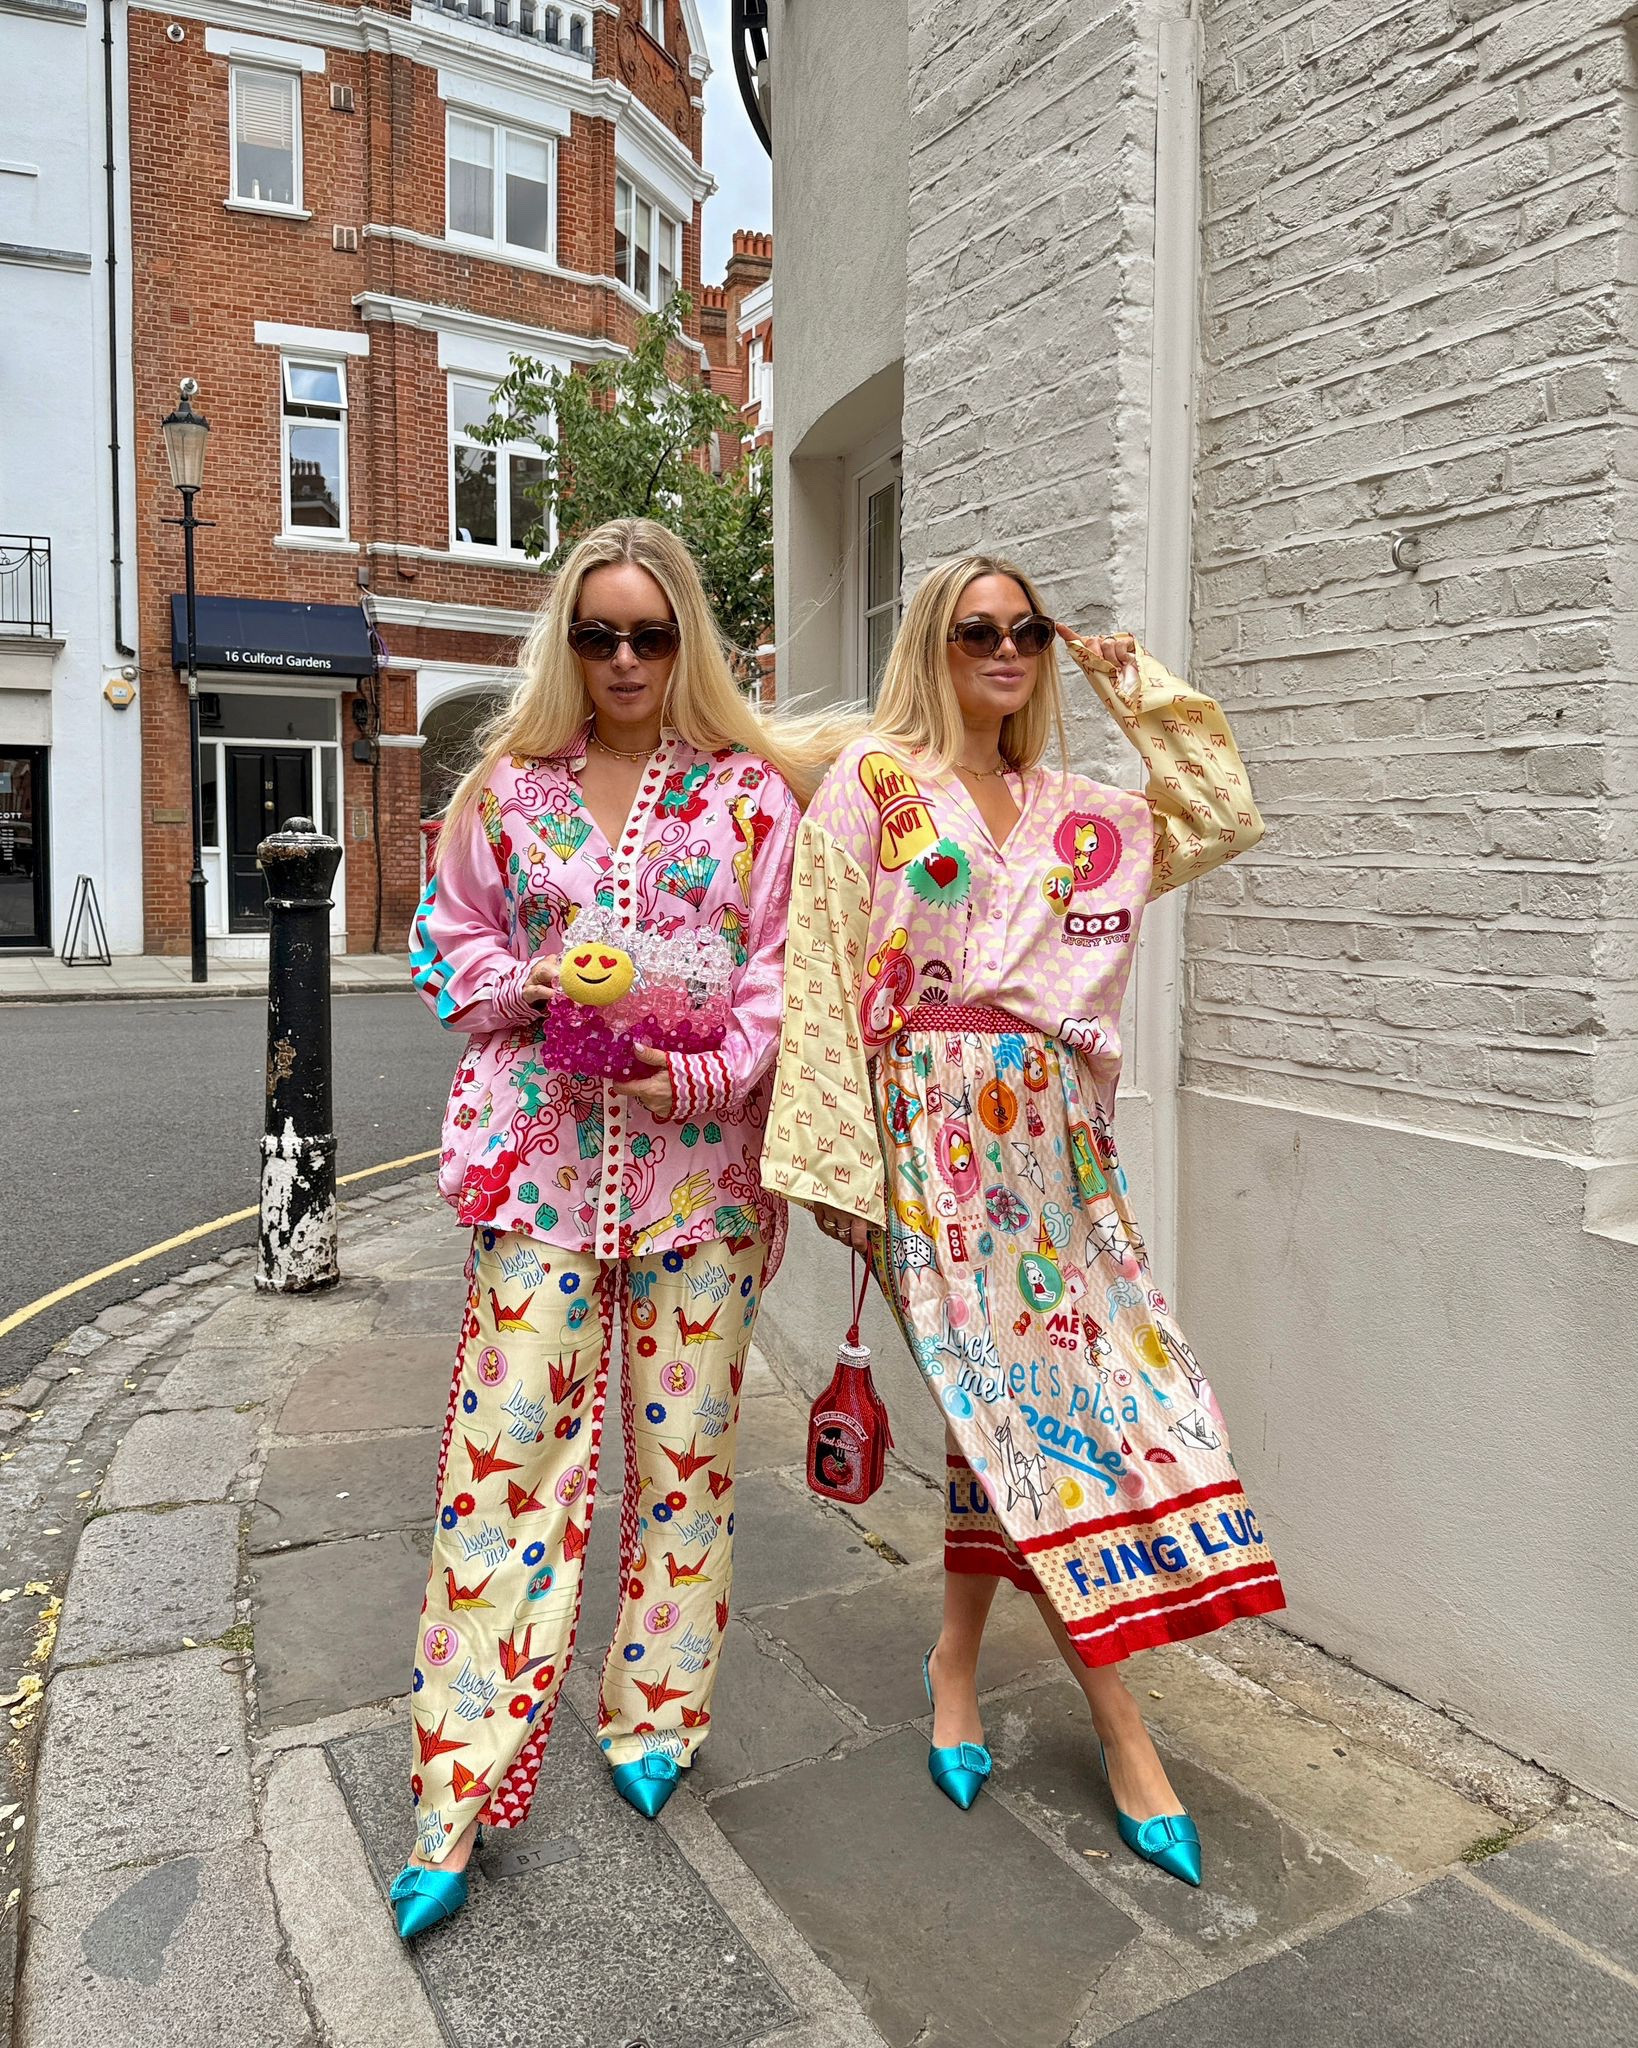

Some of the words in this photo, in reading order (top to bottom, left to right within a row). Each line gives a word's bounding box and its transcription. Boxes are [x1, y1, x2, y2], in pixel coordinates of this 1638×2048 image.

[225, 651, 239, 662] 16
[242, 652, 283, 666] Culford
[286, 656, 331, 669] Gardens
[874, 768, 908, 802] WHY
[885, 807, 922, 858] NOT
[1061, 934, 1101, 947] LUCKY
[1103, 933, 1130, 945] YOU
[494, 1242, 543, 1283] Lucky
[682, 1260, 731, 1300] Lucky
[1045, 1312, 1080, 1335] ME
[1049, 1333, 1078, 1351] 369
[500, 1379, 548, 1426] Lucky
[819, 1433, 835, 1446] Red
[835, 1438, 859, 1452] Sauce
[456, 1520, 509, 1562] Lucky
[448, 1656, 499, 1699] Lucky
[516, 1850, 542, 1865] BT
